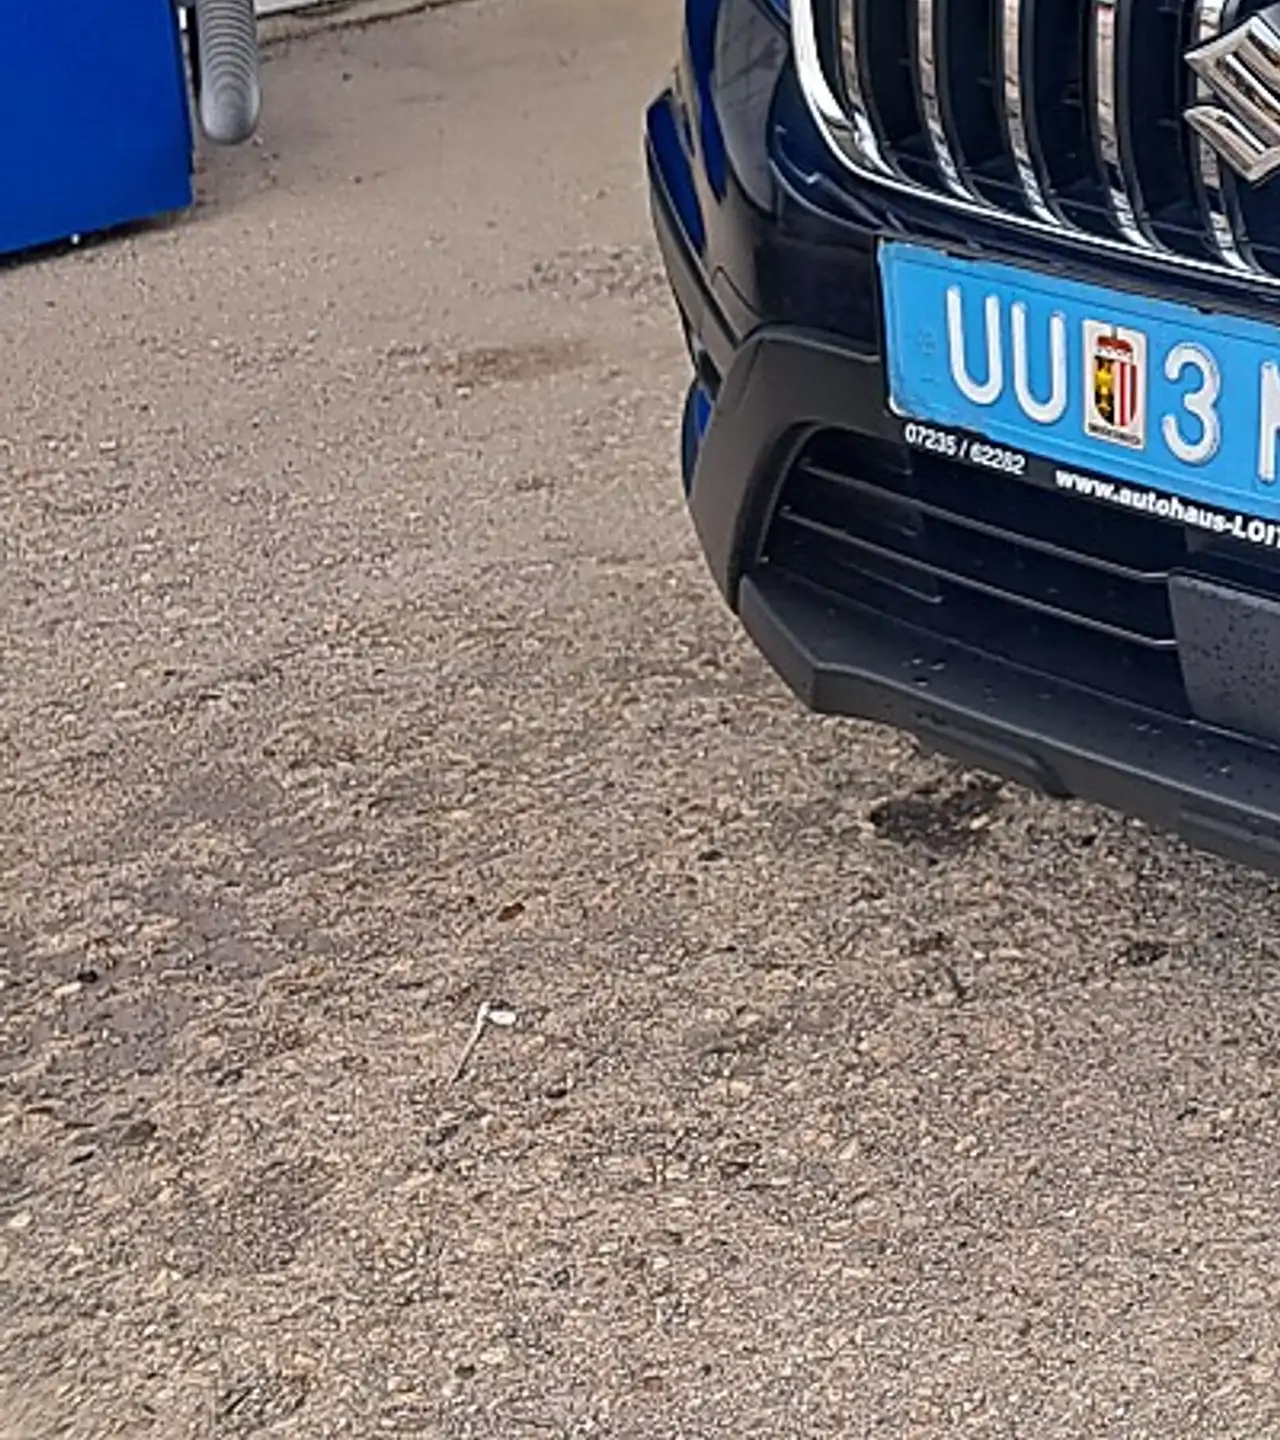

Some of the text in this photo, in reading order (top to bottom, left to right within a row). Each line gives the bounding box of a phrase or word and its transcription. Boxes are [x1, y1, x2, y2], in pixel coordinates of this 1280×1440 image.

[947, 285, 1067, 424] UU
[1162, 341, 1221, 462] 3
[904, 422, 959, 457] 07235
